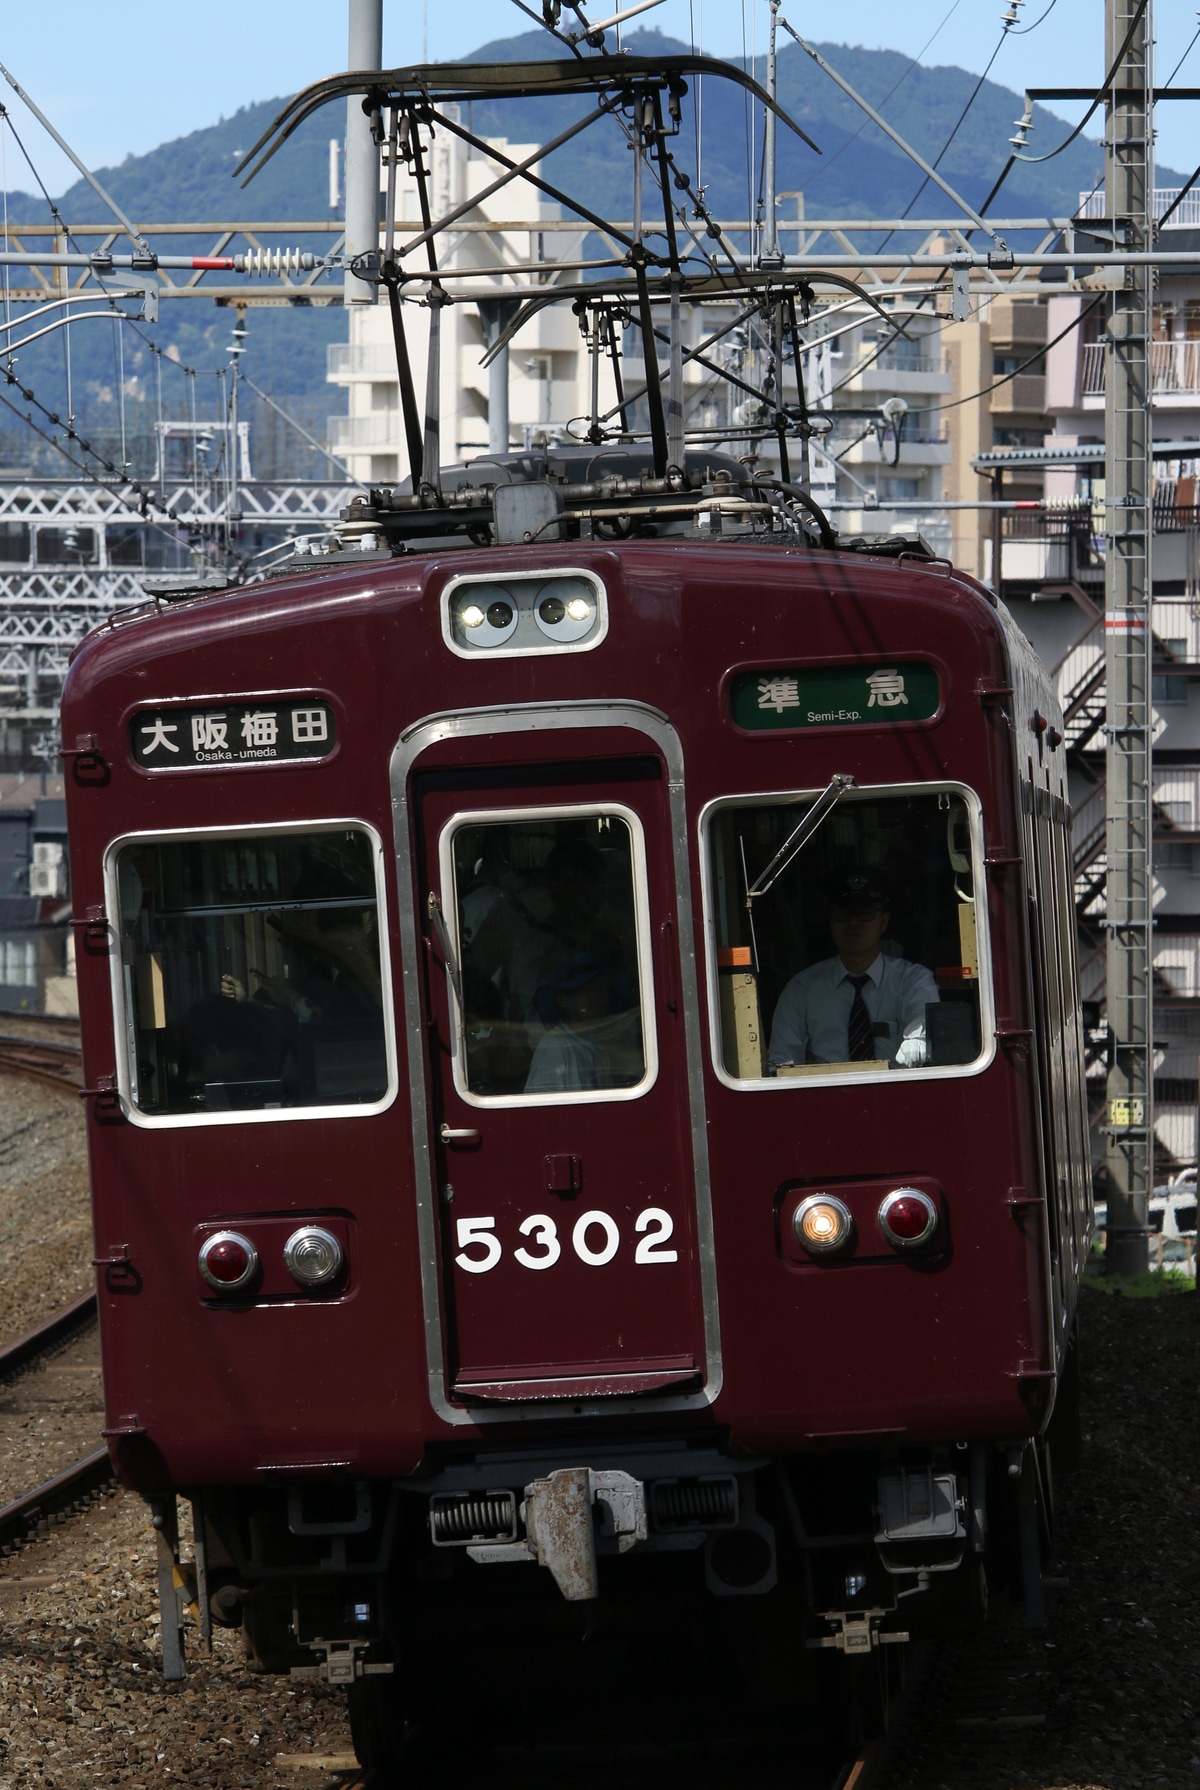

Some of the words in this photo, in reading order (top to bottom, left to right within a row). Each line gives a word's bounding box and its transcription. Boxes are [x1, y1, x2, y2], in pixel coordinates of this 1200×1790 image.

[757, 668, 909, 713] 準急
[141, 707, 329, 755] 大阪梅田
[807, 709, 862, 723] Semi-Exp.
[195, 747, 277, 762] Osaka-umeda
[455, 1207, 678, 1274] 5302
